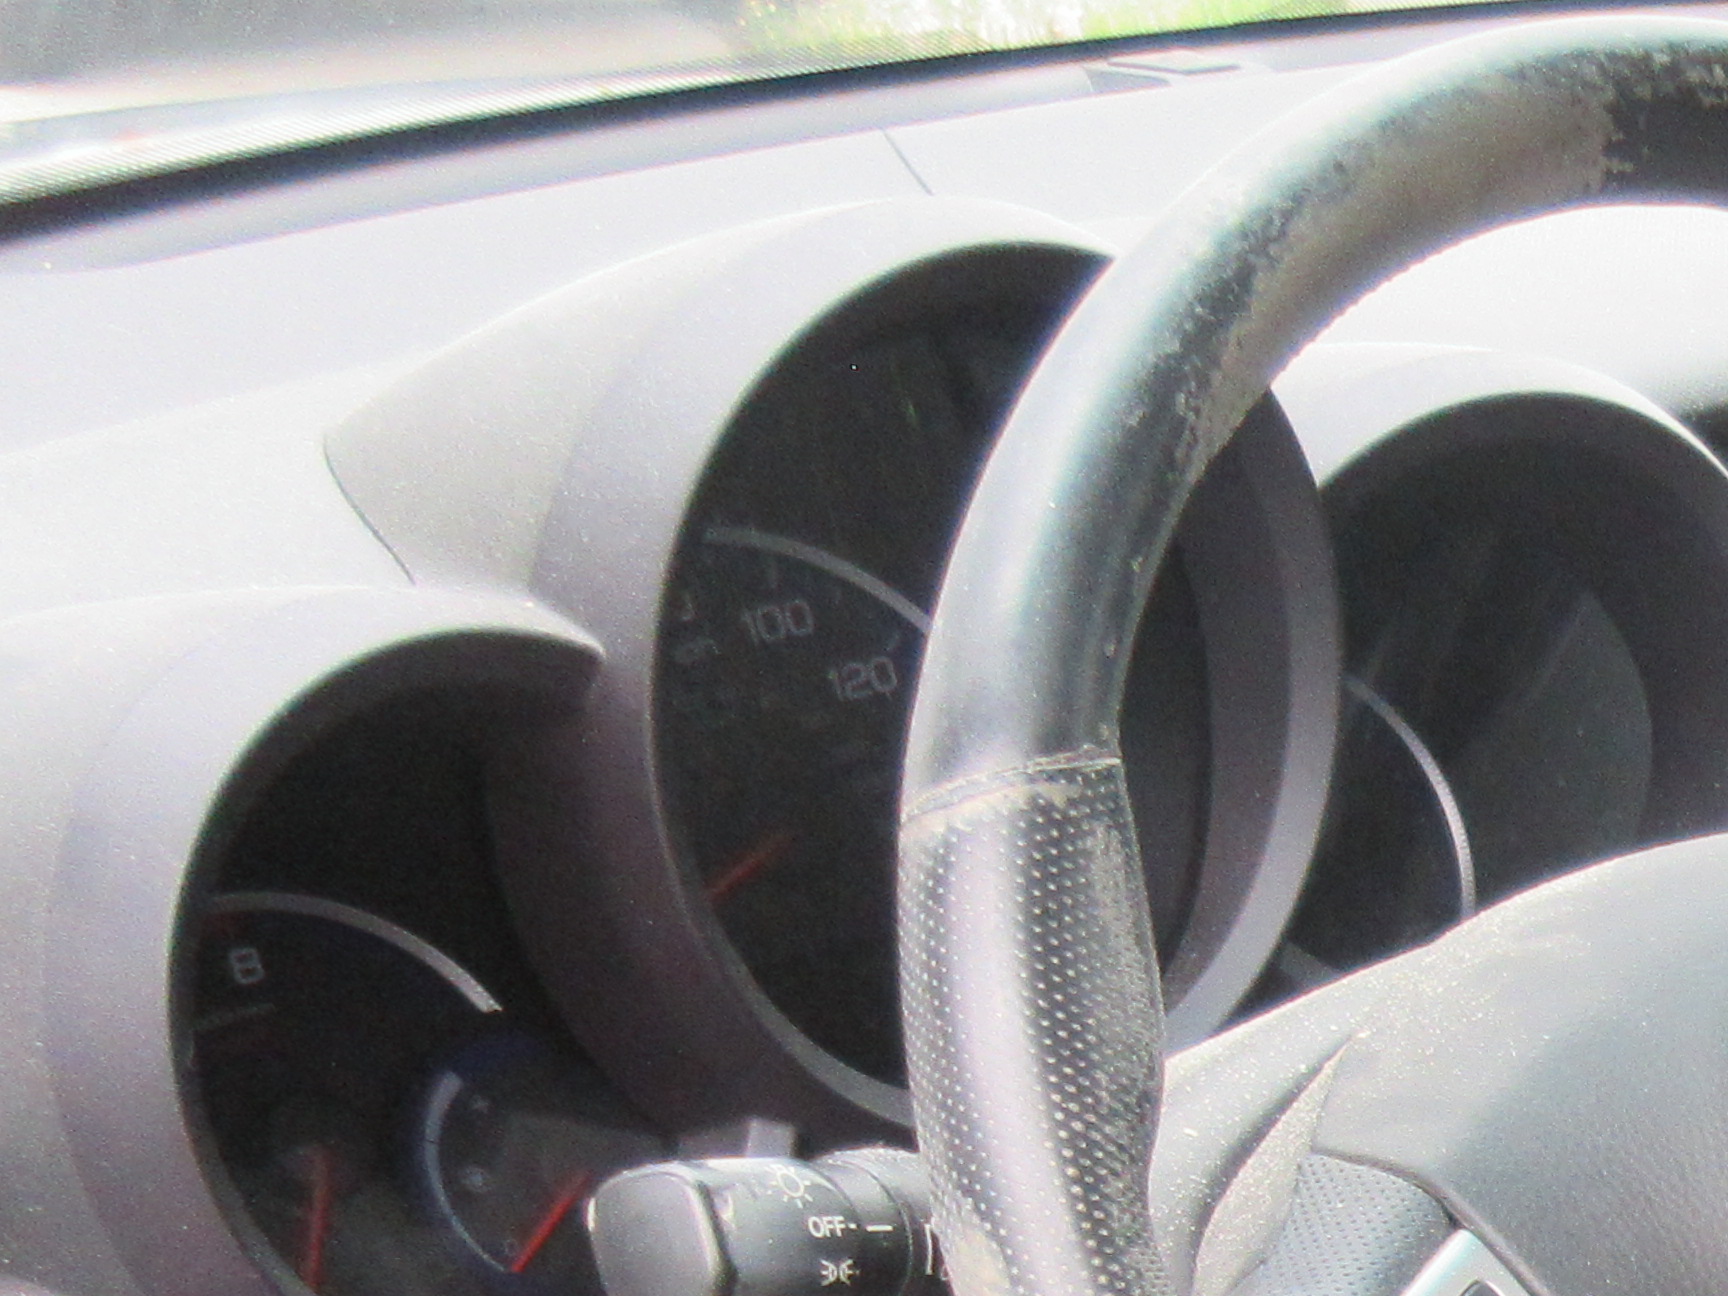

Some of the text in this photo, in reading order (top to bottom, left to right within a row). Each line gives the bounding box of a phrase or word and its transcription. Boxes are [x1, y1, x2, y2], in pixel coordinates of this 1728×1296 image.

[741, 599, 815, 647] 100
[826, 654, 899, 703] 120
[808, 1215, 846, 1238] OFF
